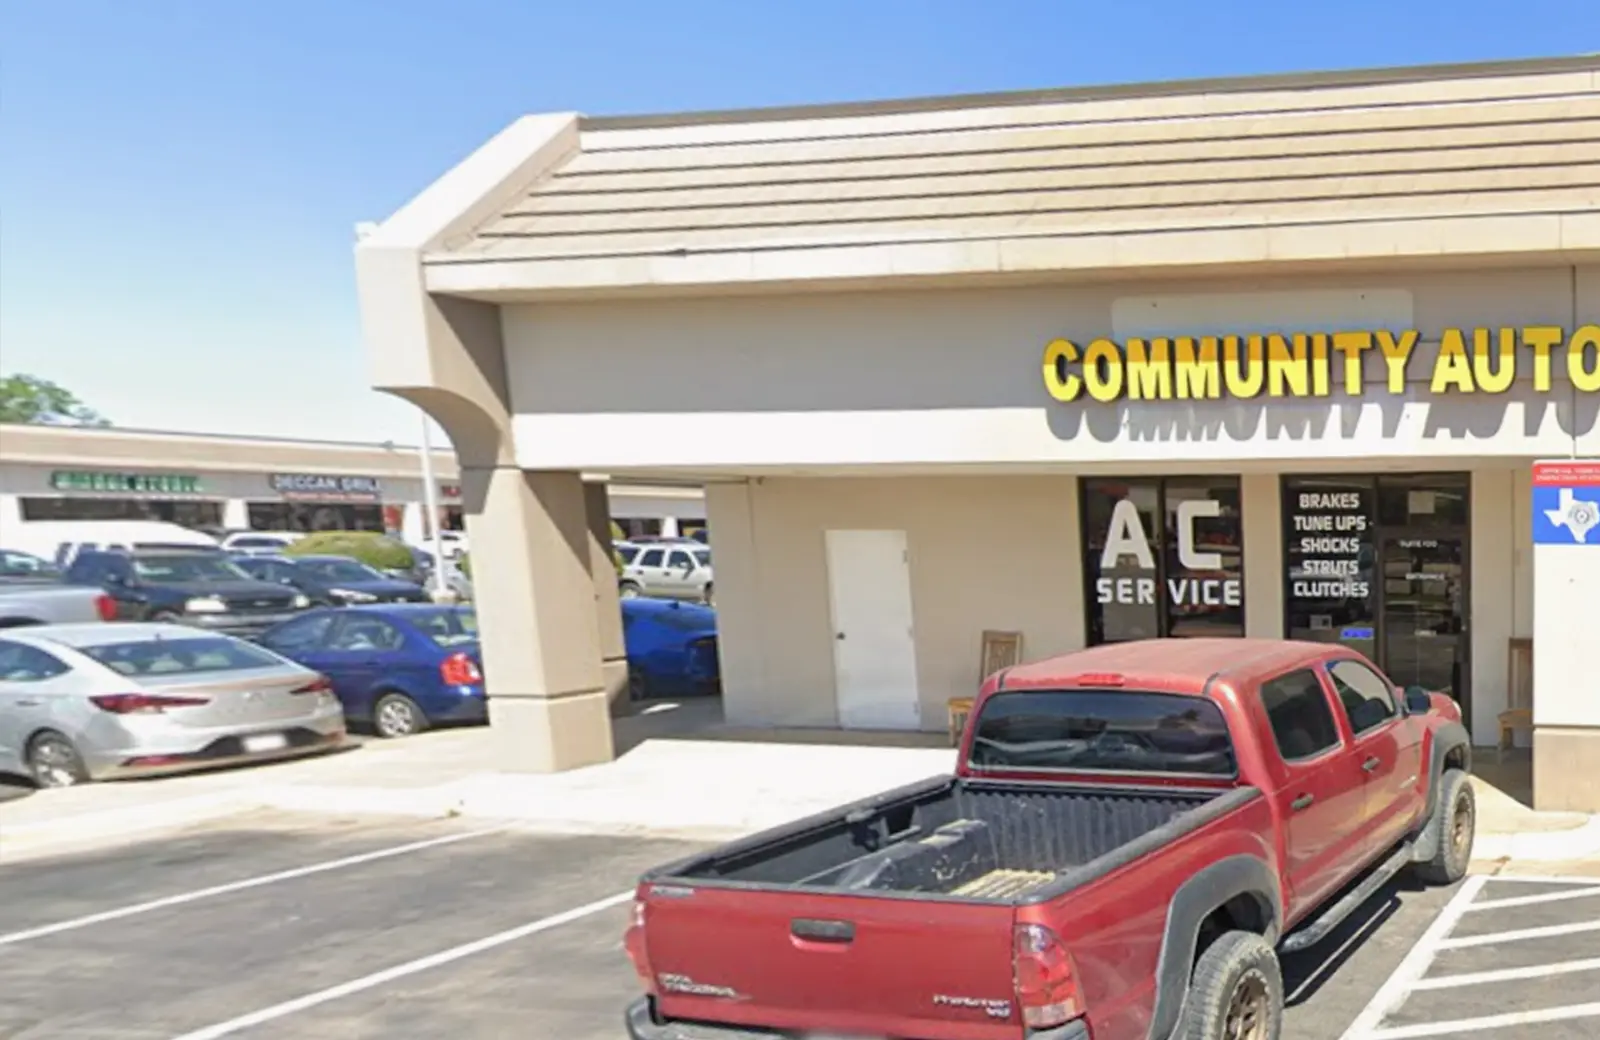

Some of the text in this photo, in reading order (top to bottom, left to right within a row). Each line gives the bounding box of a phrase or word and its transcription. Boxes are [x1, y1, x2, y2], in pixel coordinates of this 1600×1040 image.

[1043, 329, 1418, 402] COMMUNITY
[1299, 493, 1360, 509] BRAKES
[1293, 515, 1366, 531] TUNE UPS
[1300, 537, 1360, 553] SHOCKS
[1302, 559, 1358, 576] STRUTS
[1096, 577, 1241, 605] SERVICE
[1293, 581, 1369, 597] CLUTCHES
